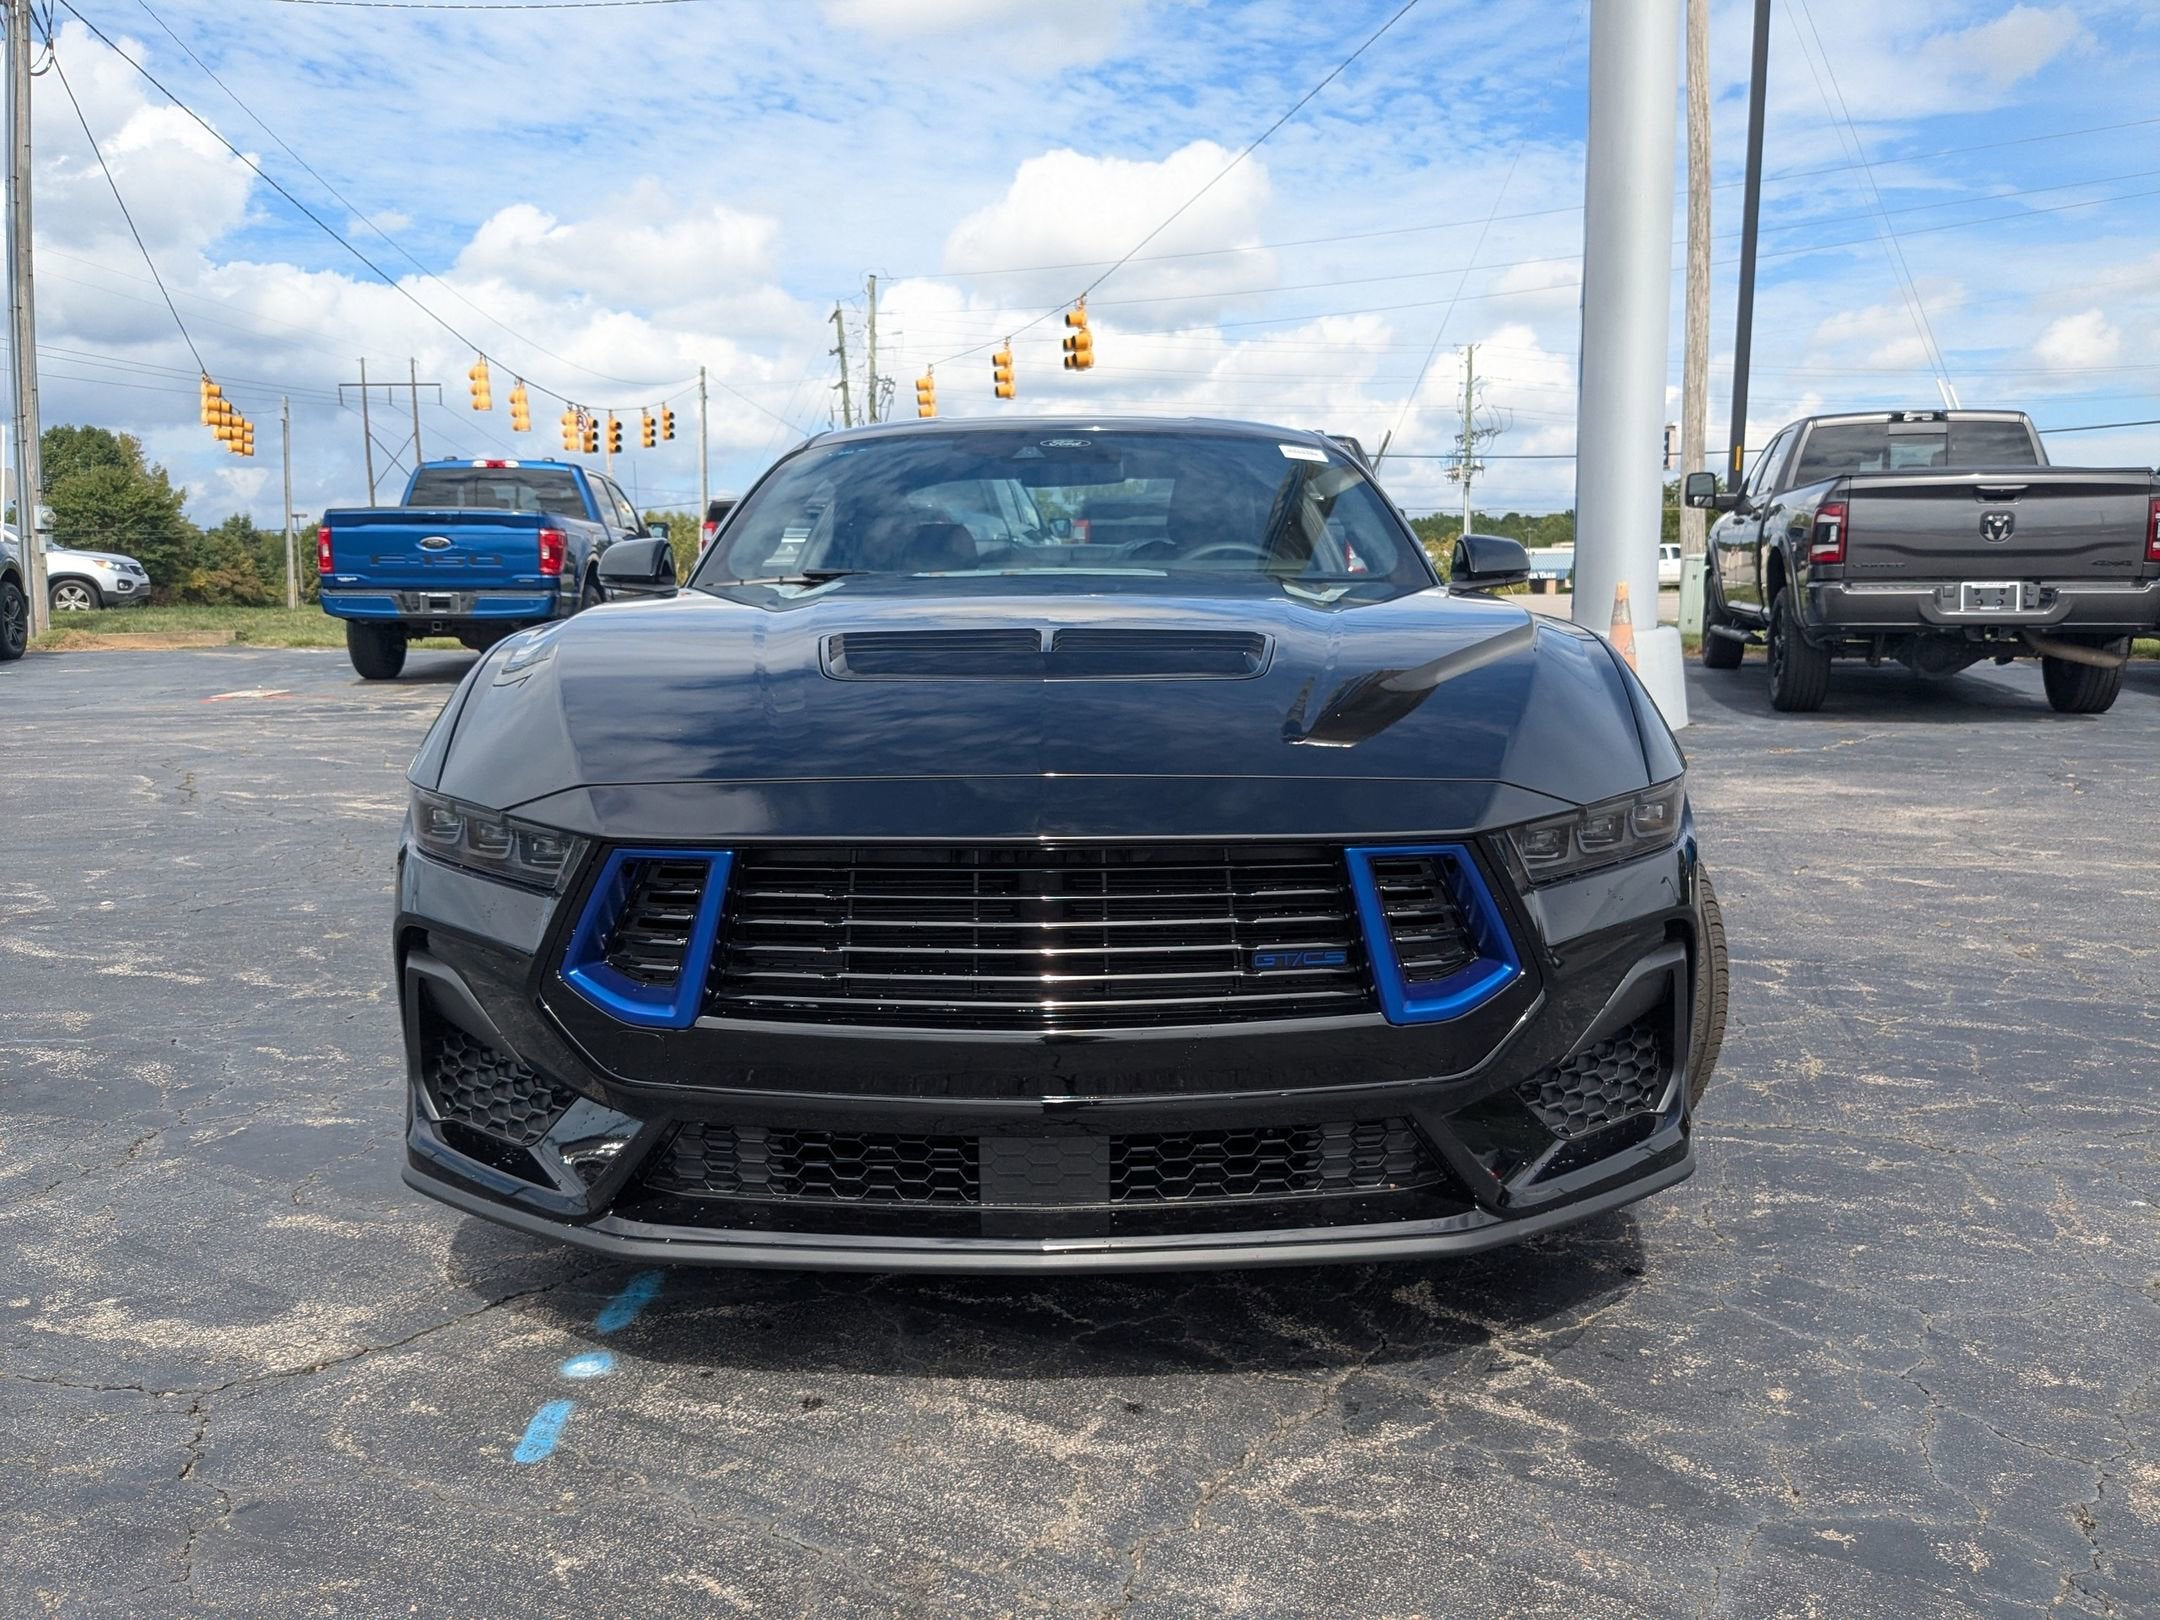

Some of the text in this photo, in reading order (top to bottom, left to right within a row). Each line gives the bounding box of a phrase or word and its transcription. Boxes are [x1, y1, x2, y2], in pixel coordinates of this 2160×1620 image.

[1049, 438, 1082, 448] Ford
[370, 553, 504, 568] F-150
[1254, 950, 1346, 967] GT/CS
